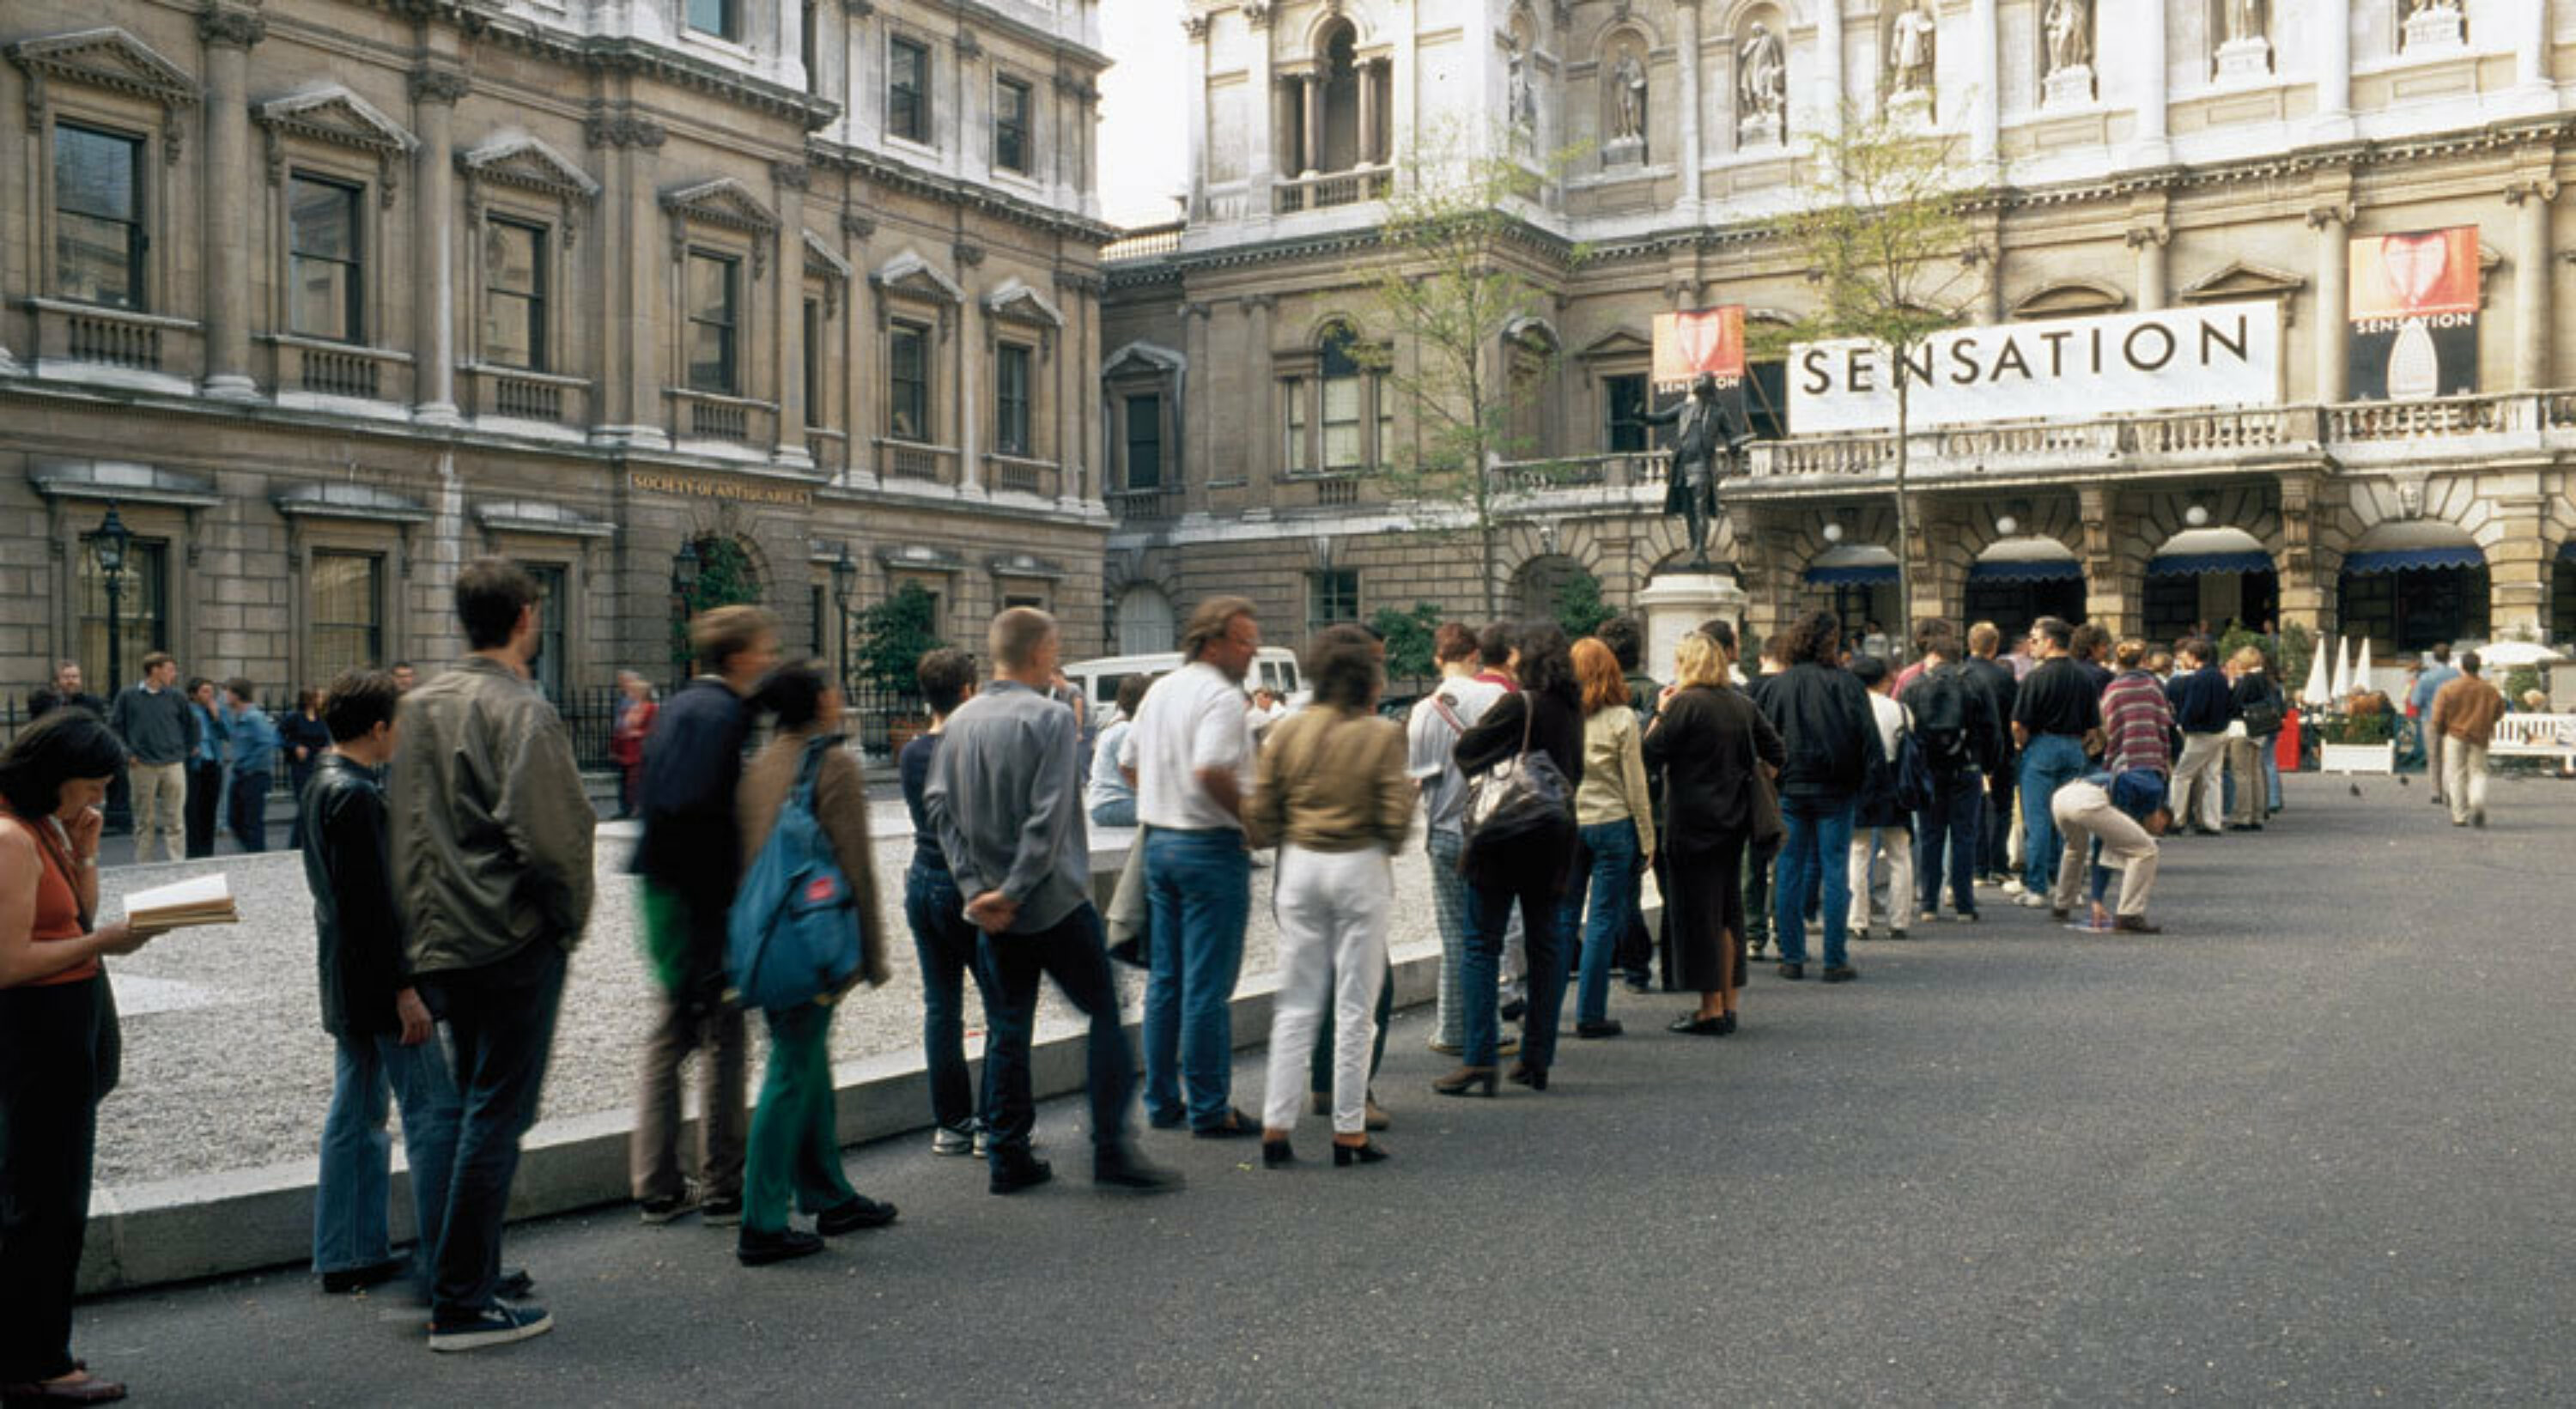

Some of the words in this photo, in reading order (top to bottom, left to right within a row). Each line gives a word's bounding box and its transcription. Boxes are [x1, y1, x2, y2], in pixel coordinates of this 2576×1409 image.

[2356, 313, 2472, 335] SENSTION
[1802, 314, 2248, 395] SENSATION
[634, 473, 695, 495] SOCIETY
[716, 482, 805, 503] ANTIQUARIES
